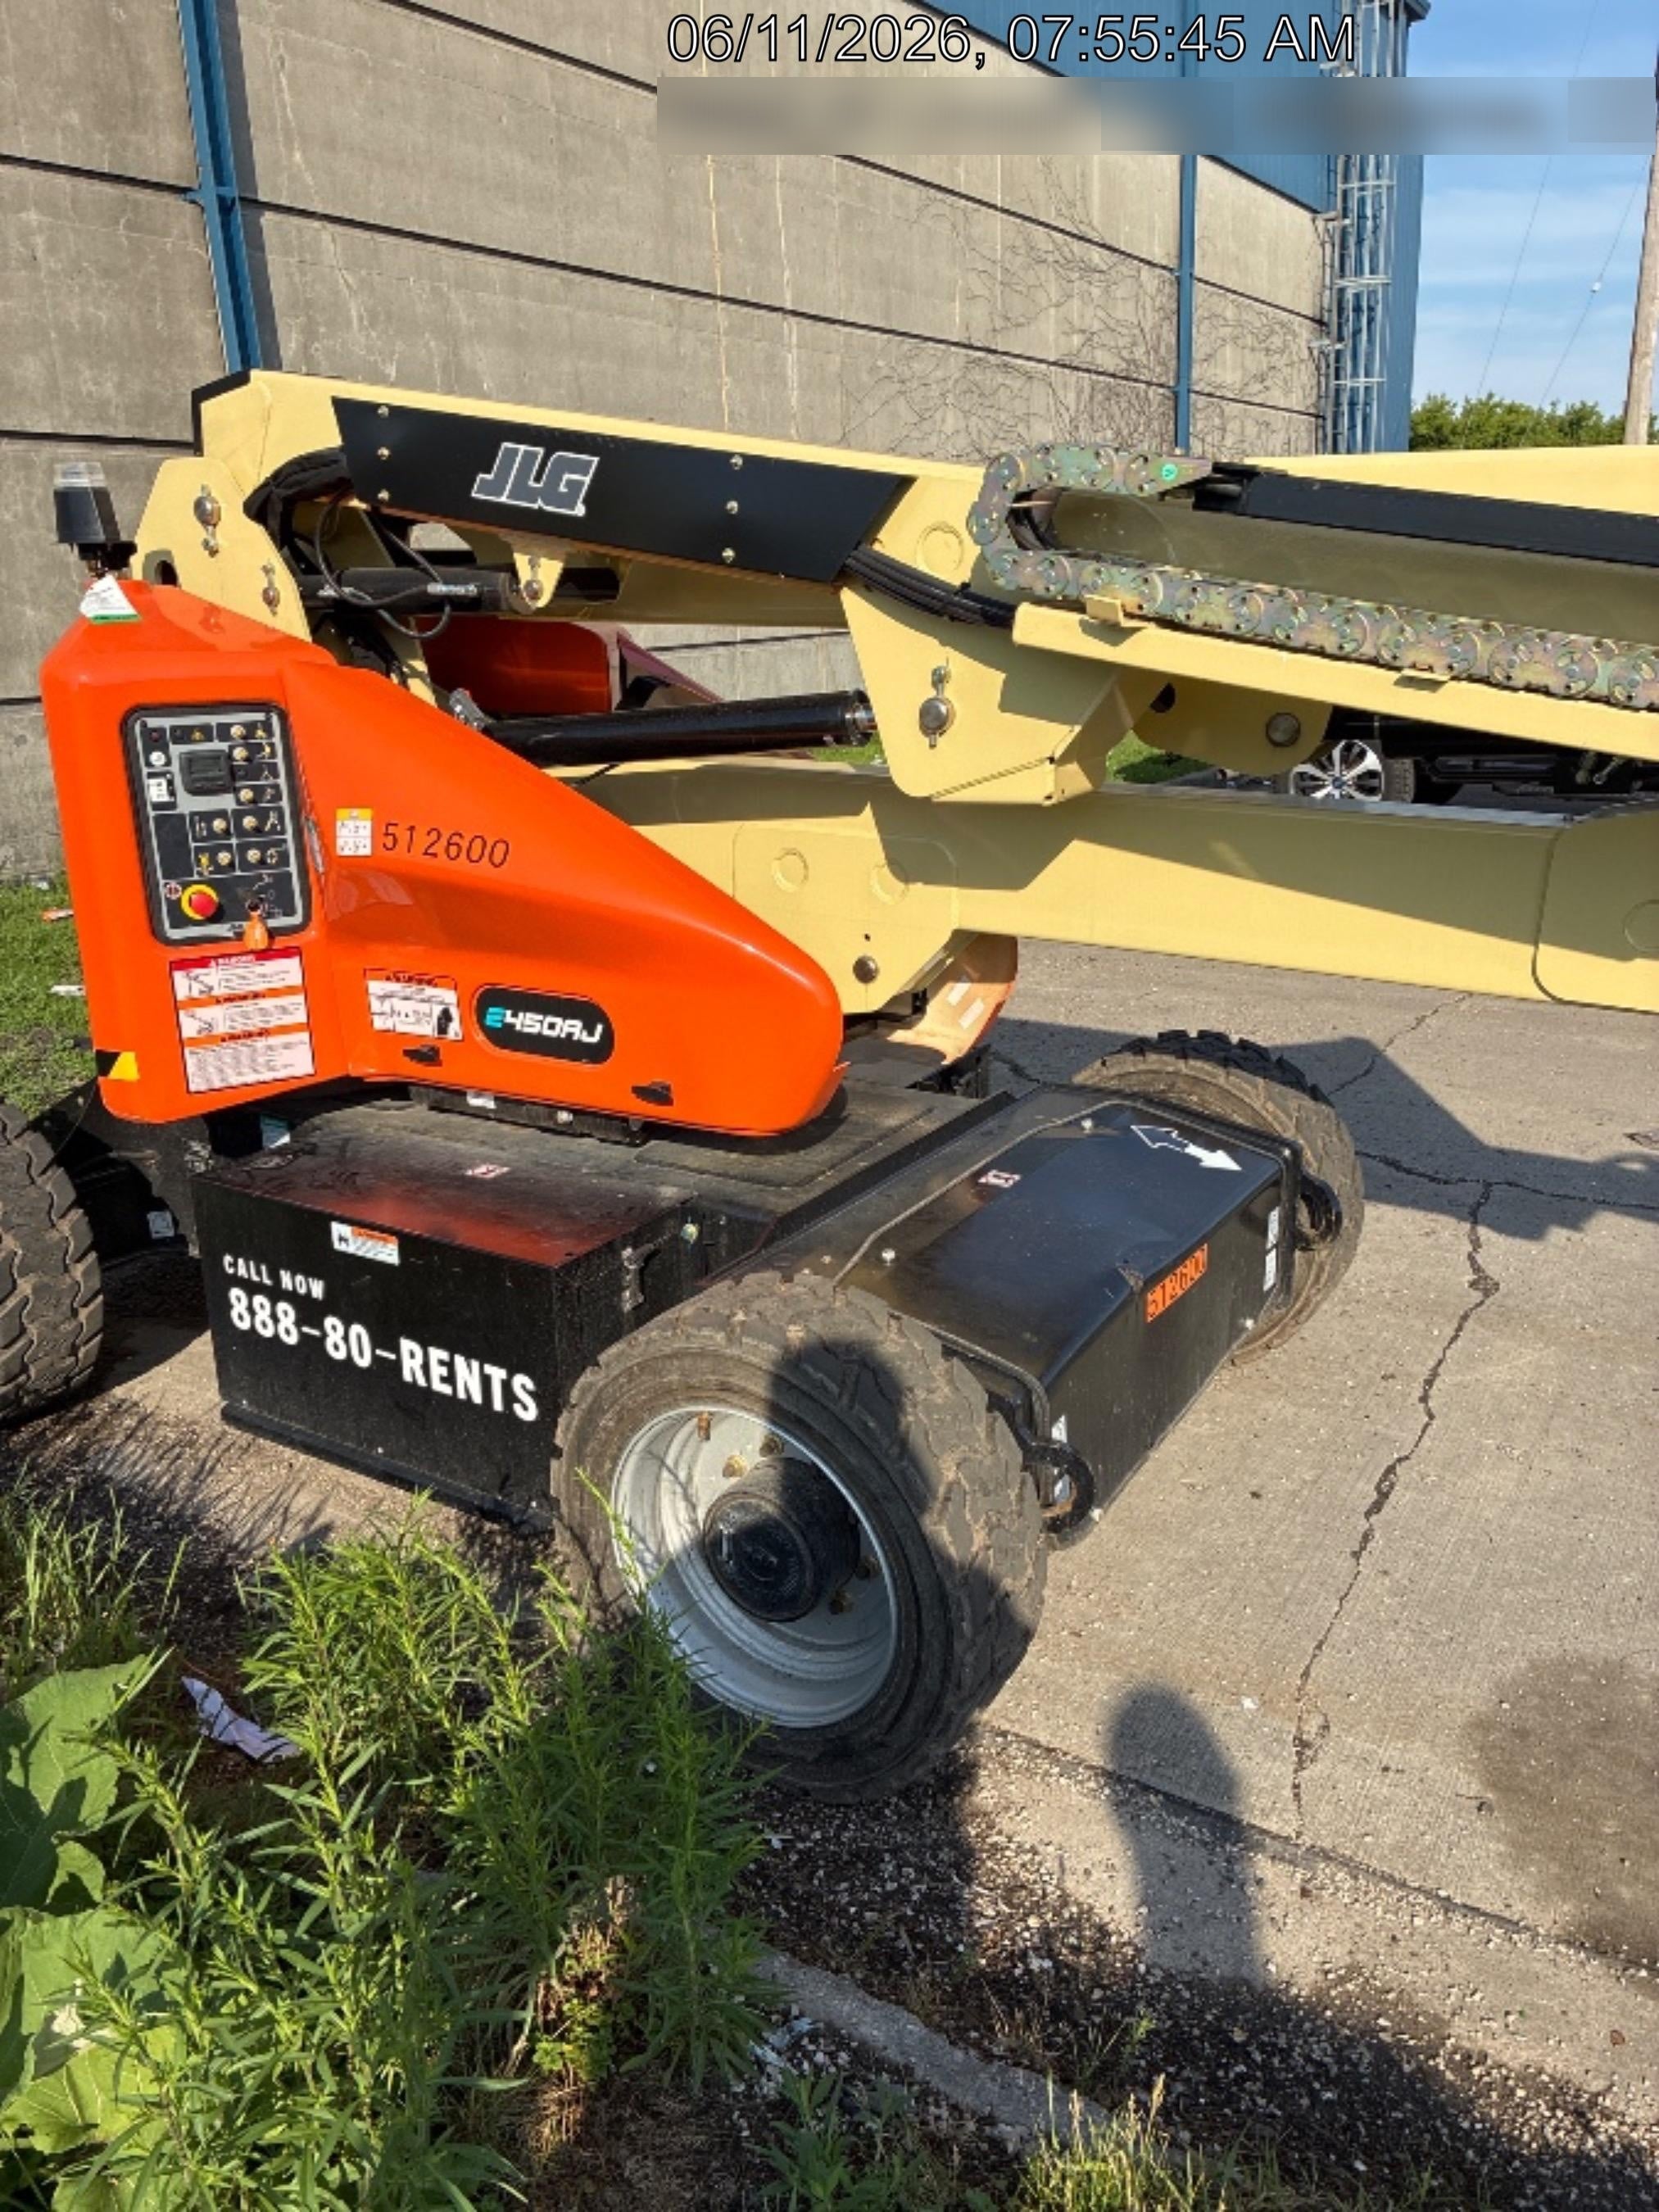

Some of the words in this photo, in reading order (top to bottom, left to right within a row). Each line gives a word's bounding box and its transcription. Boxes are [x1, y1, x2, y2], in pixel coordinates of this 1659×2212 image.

[471, 442, 601, 516] JLG
[382, 822, 510, 868] 512600
[485, 1006, 605, 1044] E450AJ
[223, 1253, 273, 1285] CALL
[280, 1269, 325, 1301] NOW
[228, 1286, 539, 1422] 888-80-RENTS
